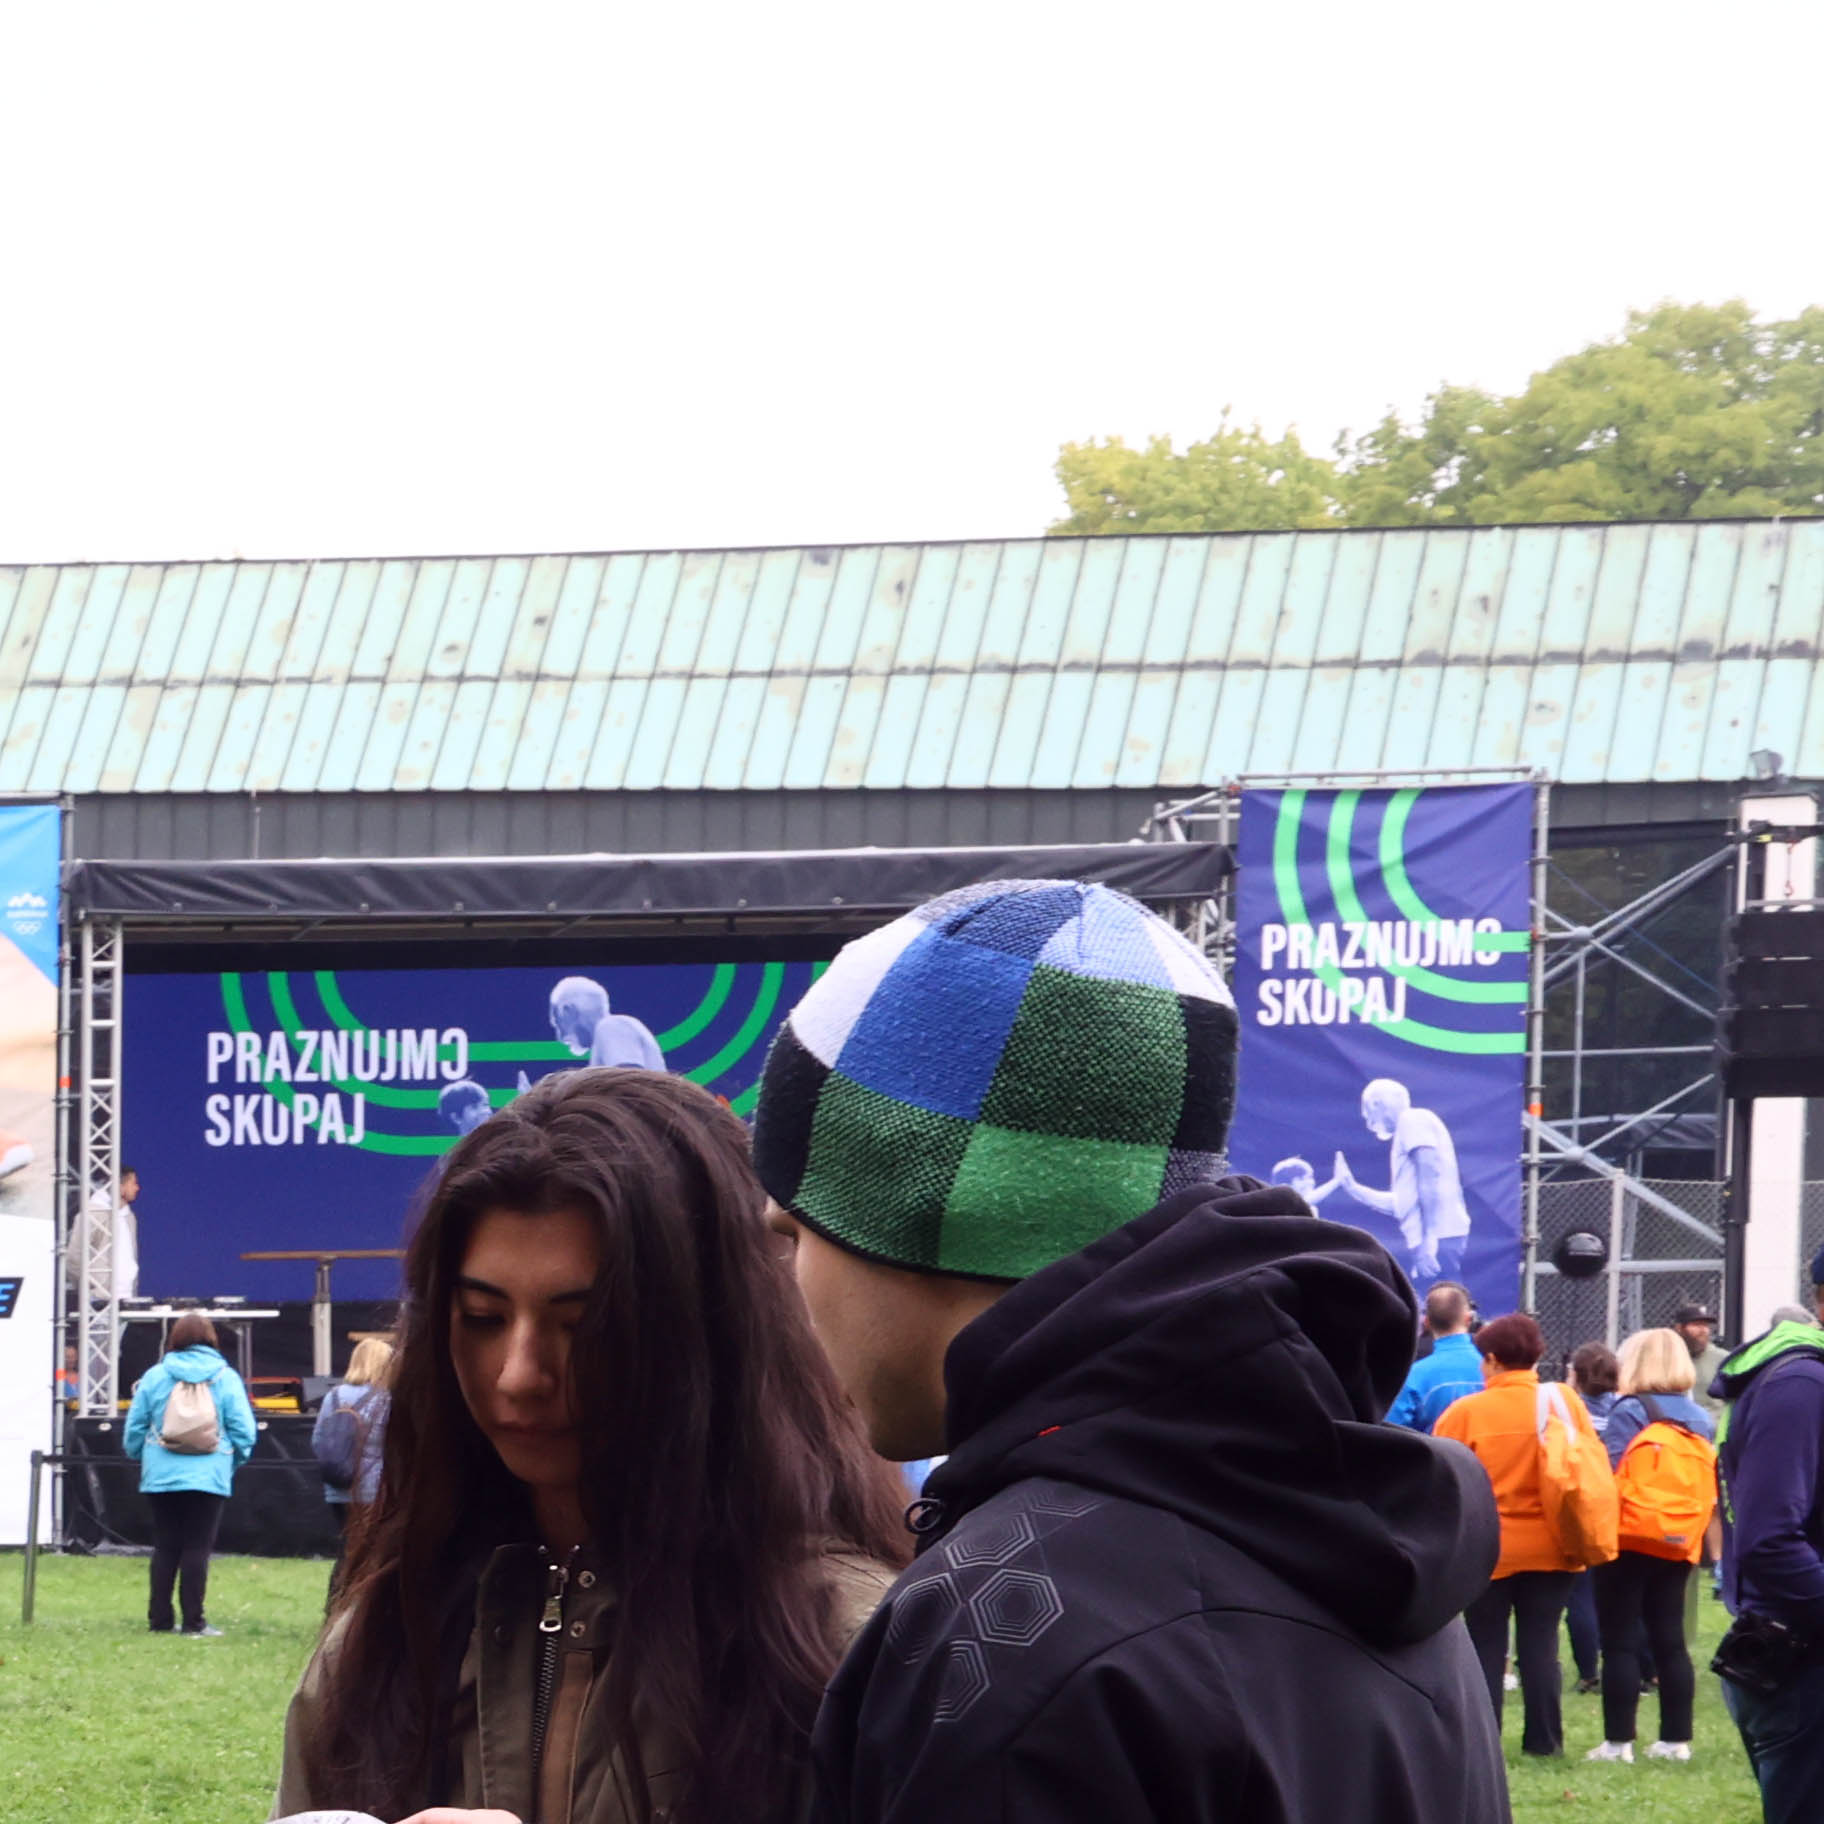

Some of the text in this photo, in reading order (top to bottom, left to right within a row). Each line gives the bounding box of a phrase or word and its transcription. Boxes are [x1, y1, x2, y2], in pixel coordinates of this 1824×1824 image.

[1261, 918, 1502, 970] PRAZNUJMO
[1257, 977, 1406, 1026] SKUPAJ
[207, 1028, 469, 1083] PRAZNUJMO
[205, 1093, 365, 1146] SKUPAJ
